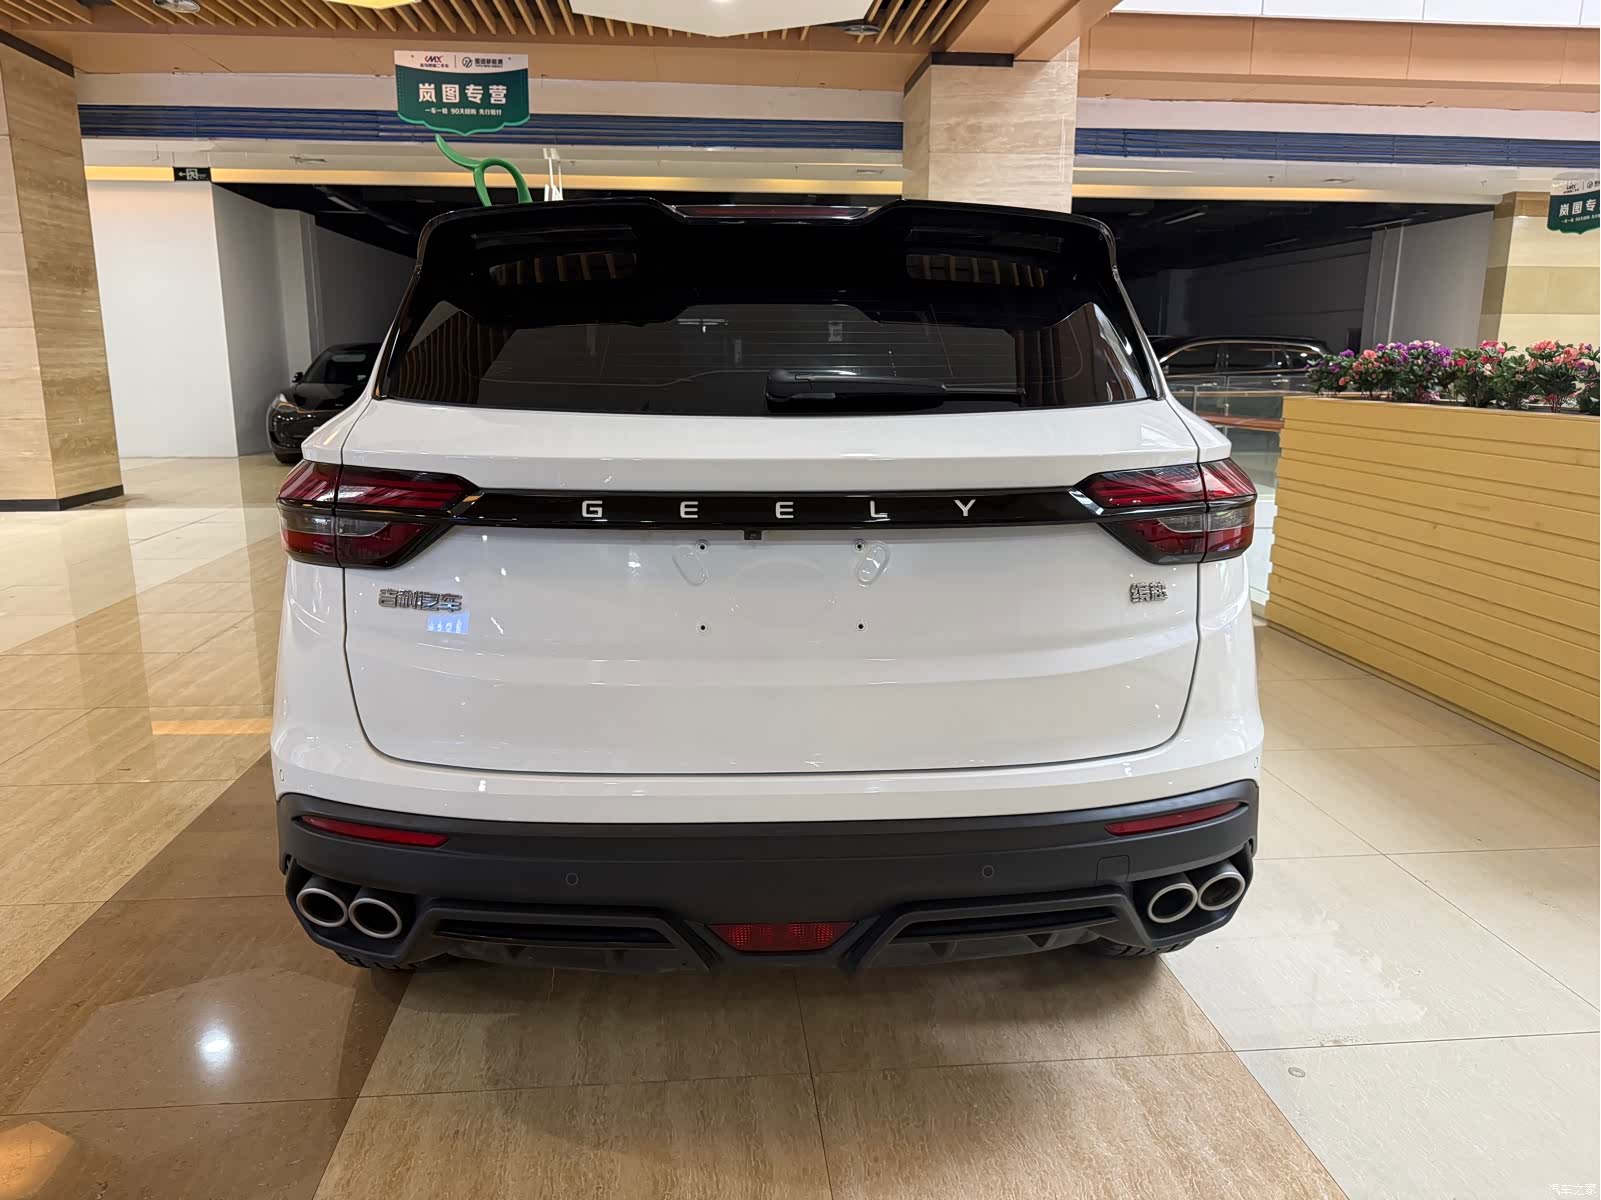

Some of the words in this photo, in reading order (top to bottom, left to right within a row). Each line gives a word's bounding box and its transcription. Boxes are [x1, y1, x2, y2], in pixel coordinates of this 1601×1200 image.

[418, 83, 508, 104] 岚图专营
[1559, 199, 1597, 217] 岚图专
[581, 499, 976, 519] GEELY
[379, 588, 463, 612] 吉利汽车
